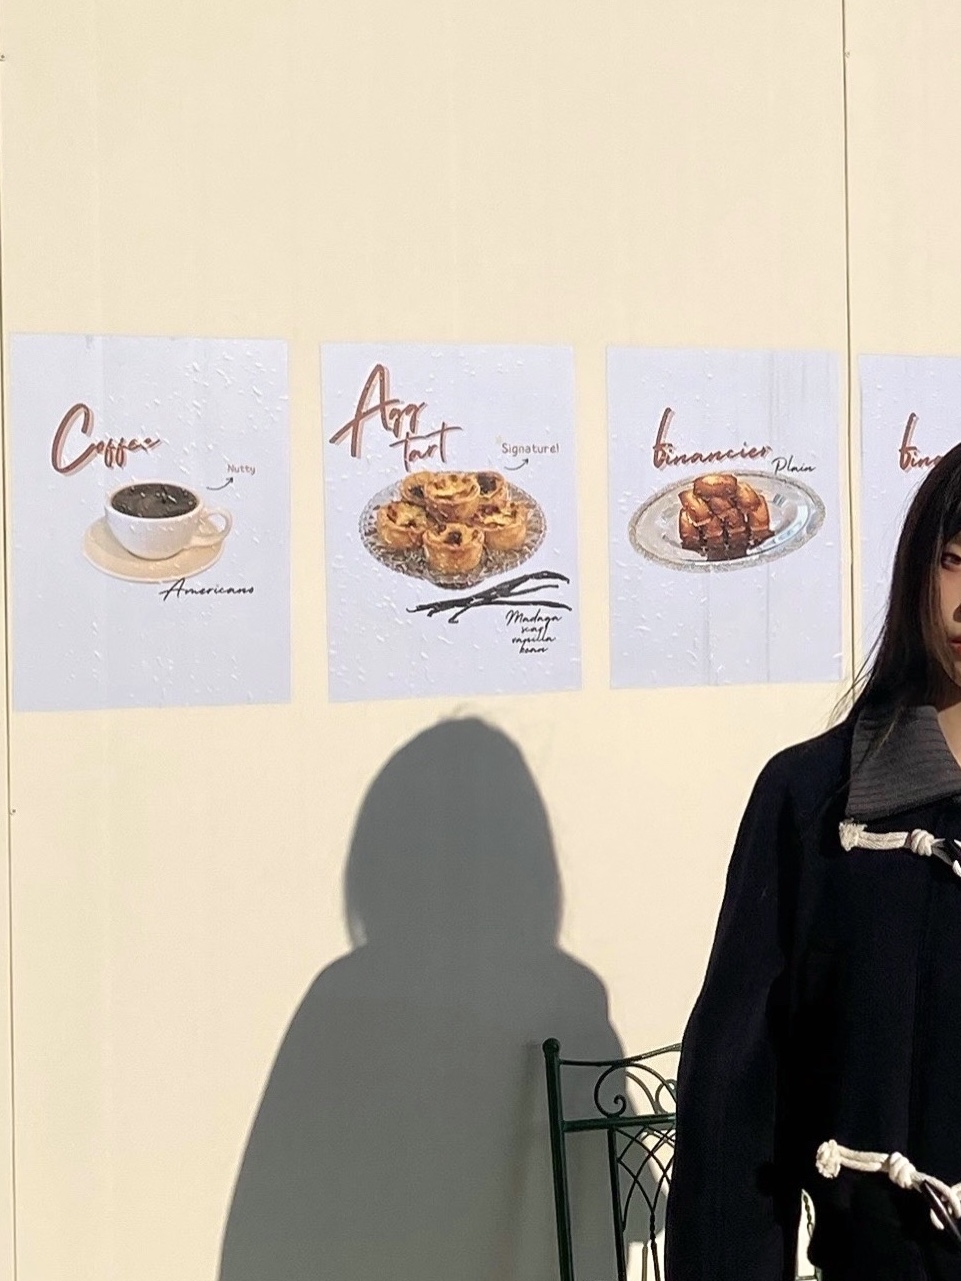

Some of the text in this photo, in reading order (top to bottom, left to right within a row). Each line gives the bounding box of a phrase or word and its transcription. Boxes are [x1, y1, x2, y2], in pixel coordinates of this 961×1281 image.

[51, 403, 161, 476] Coffee
[227, 463, 256, 476] Nutty
[159, 577, 254, 601] Americano
